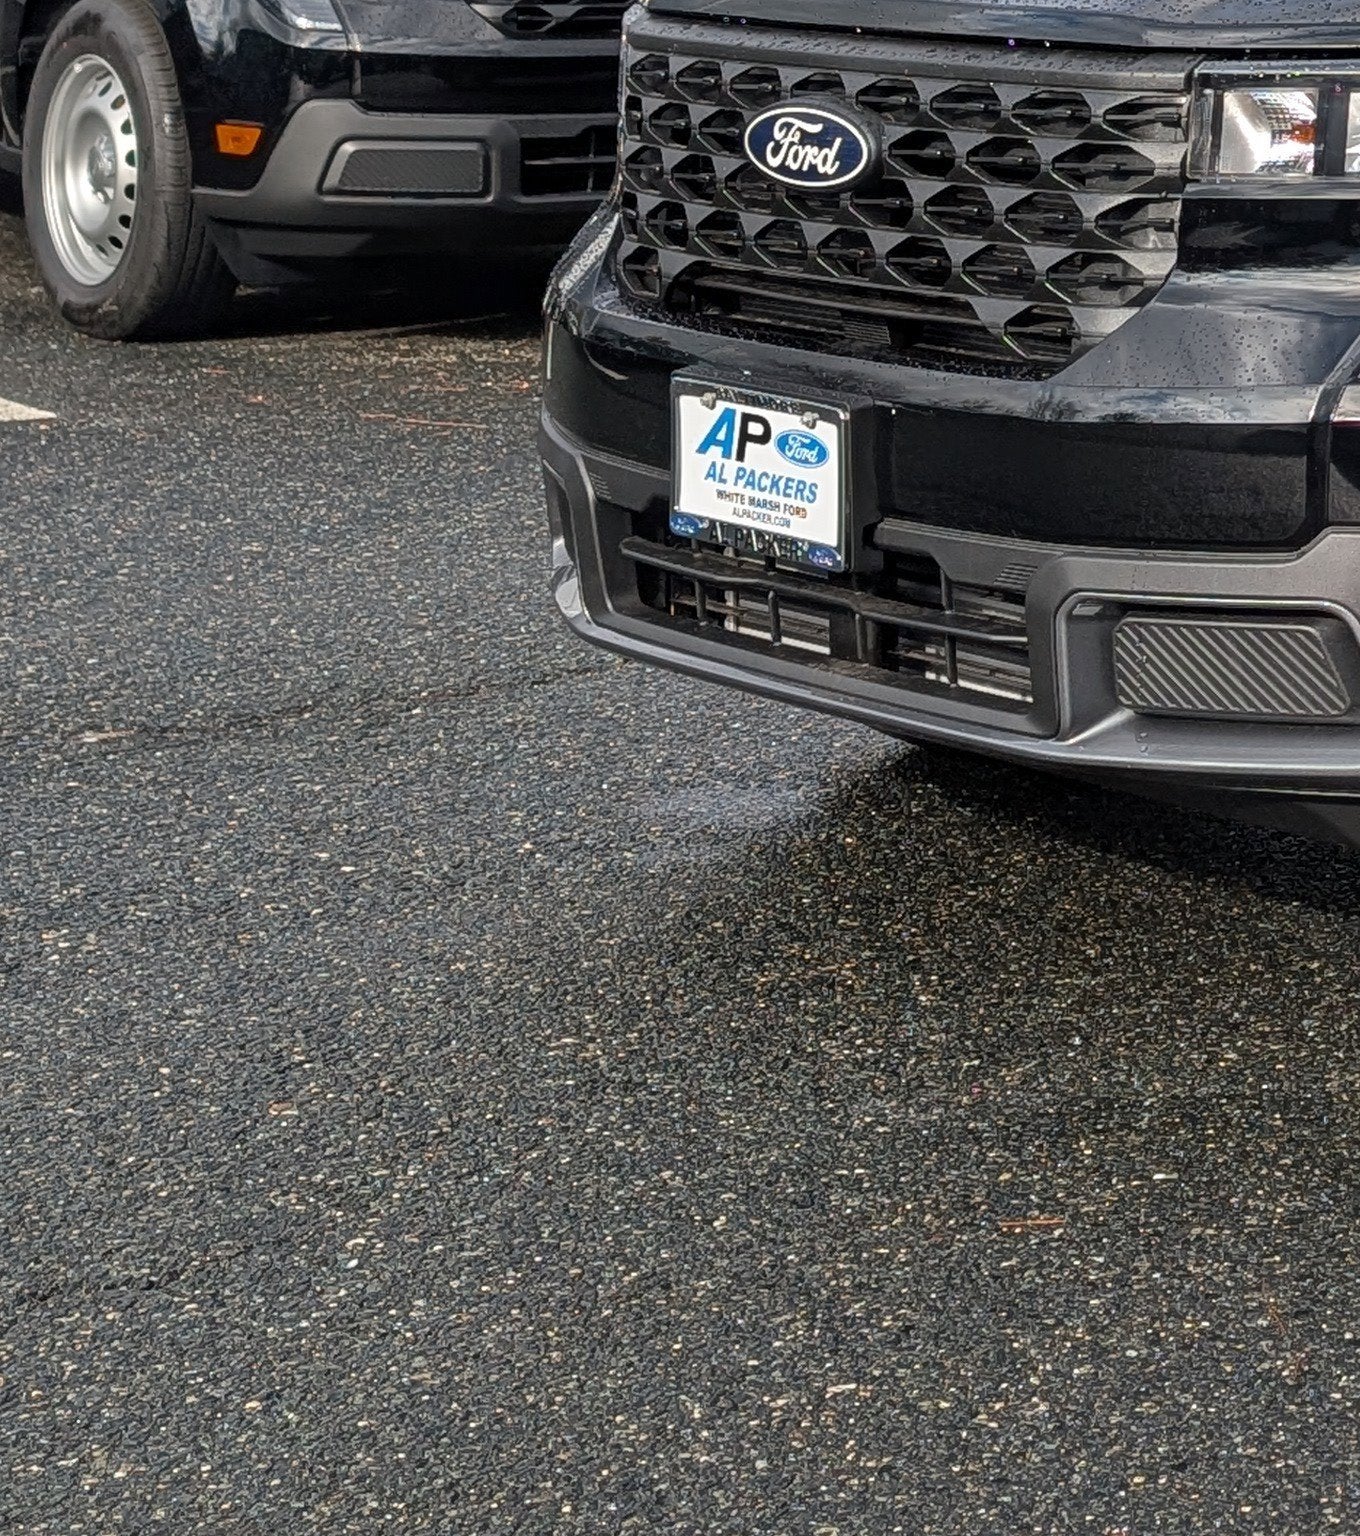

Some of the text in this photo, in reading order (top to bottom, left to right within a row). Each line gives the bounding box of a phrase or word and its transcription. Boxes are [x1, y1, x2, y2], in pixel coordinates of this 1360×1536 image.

[766, 116, 843, 175] Ford
[695, 406, 772, 463] AP
[784, 432, 820, 464] Ford
[704, 461, 819, 504] AL PACKERS
[715, 488, 808, 519] WHITE MARSH FORD
